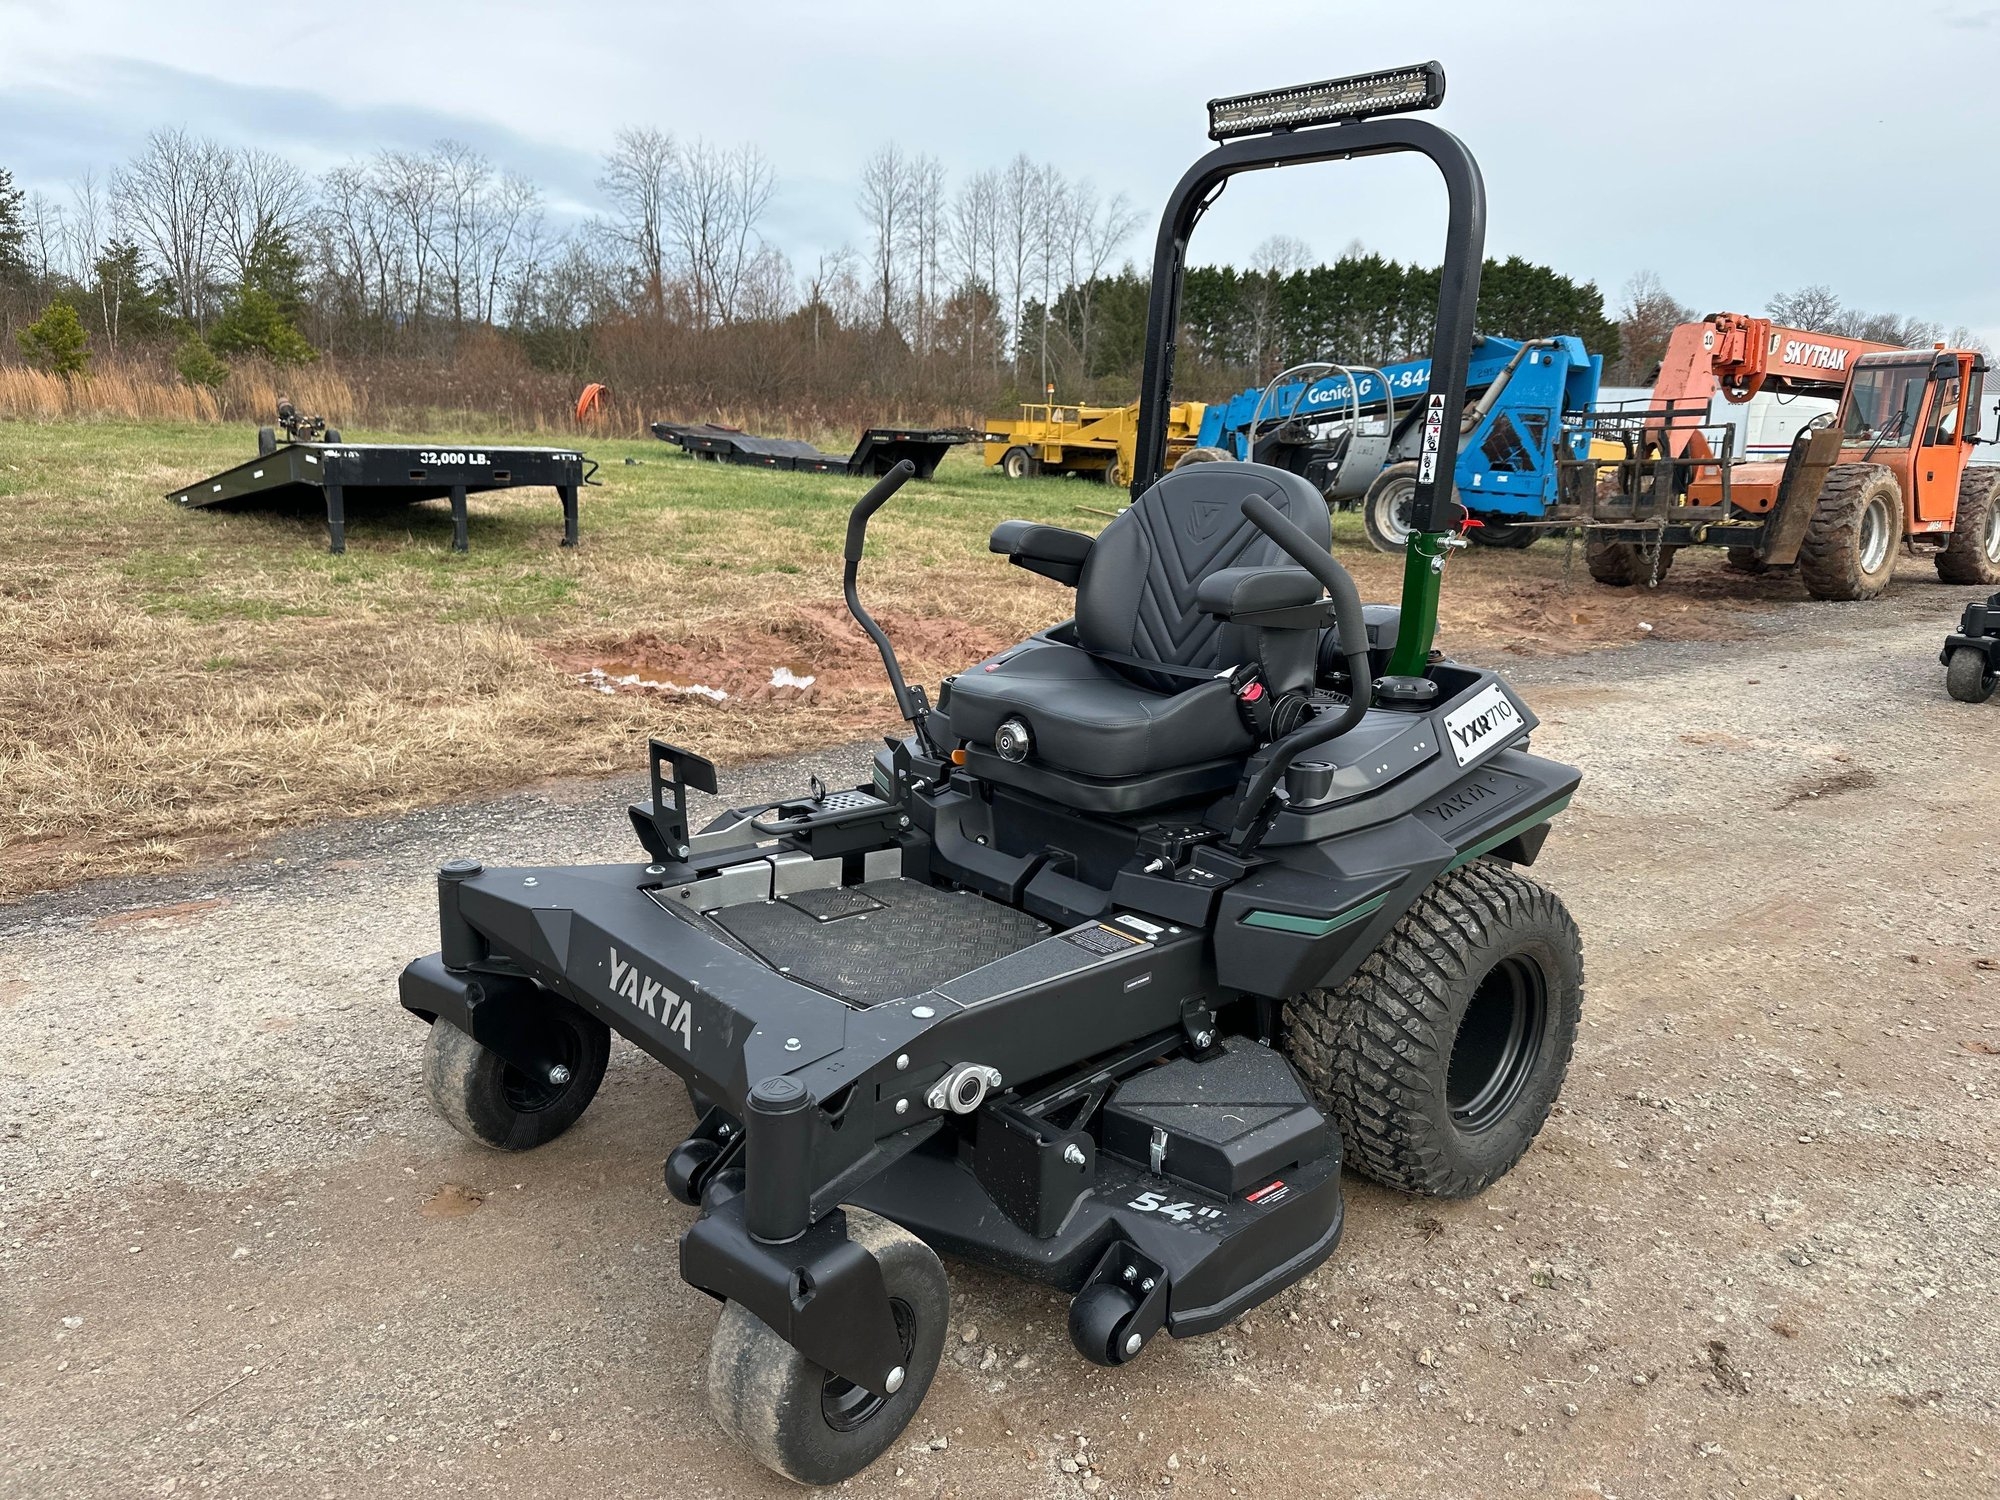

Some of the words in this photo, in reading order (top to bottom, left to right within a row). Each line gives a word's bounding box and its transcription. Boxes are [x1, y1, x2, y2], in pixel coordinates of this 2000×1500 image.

[1704, 335, 1713, 345] 10
[1783, 340, 1849, 371] SKYTRAK
[1308, 383, 1351, 404] Genie
[420, 451, 466, 466] 32,000
[469, 453, 491, 465] LB.
[1452, 700, 1512, 748] YXR710
[1425, 783, 1496, 821] YAKTA
[609, 946, 691, 1052] YAKTA
[1127, 1191, 1222, 1222] 54"
